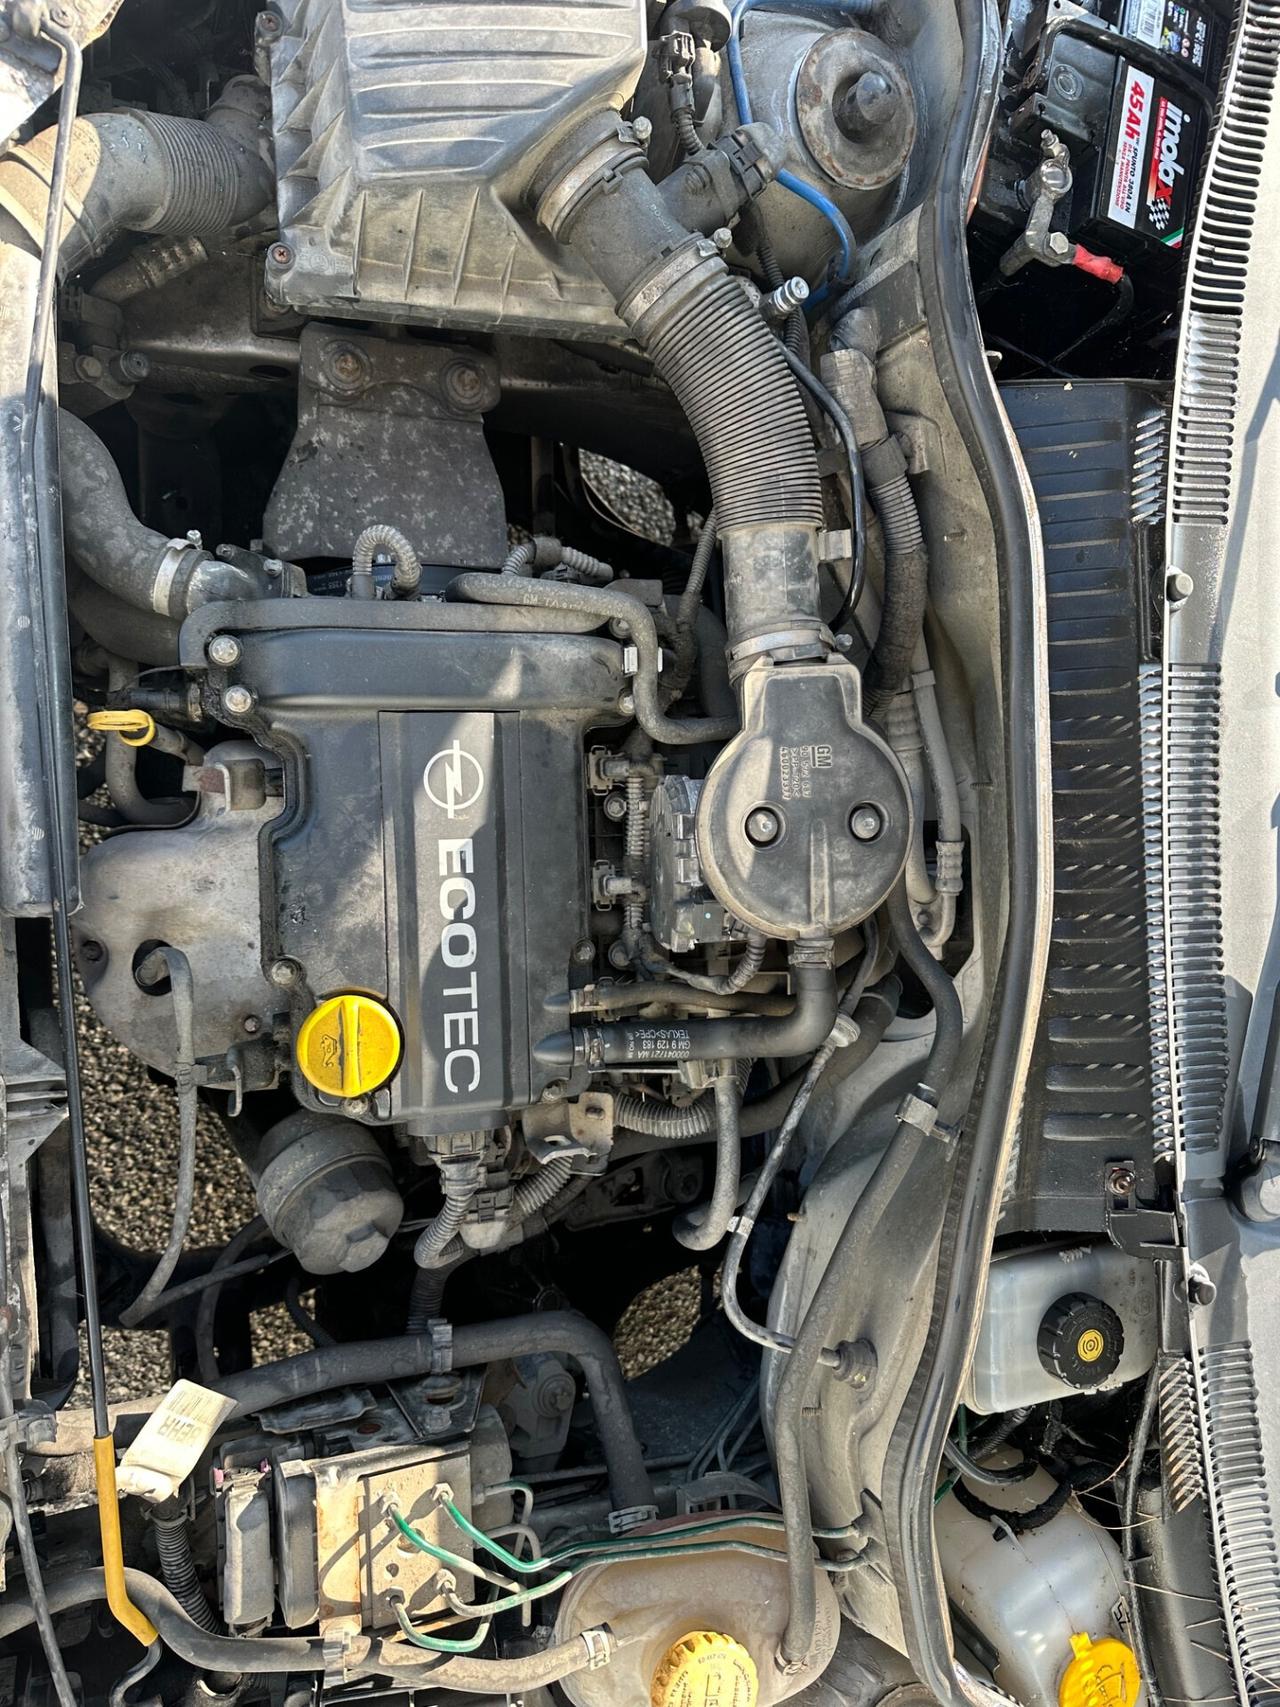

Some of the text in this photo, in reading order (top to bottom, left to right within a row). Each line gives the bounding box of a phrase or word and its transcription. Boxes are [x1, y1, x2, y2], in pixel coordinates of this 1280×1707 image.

[1125, 81, 1144, 142] 45Ah
[1130, 146, 1138, 177] SPUNTO
[1156, 101, 1190, 208] imolax
[1123, 159, 1131, 183] PRONTA
[1115, 161, 1125, 207] MANUTENZIONE
[1120, 184, 1128, 209] ALL'USO
[1125, 201, 1131, 213] EN
[817, 745, 832, 768] GM
[438, 838, 480, 1093] ECOTEC
[657, 1040, 669, 1049] 129
[671, 1040, 676, 1049] 9
[678, 1040, 690, 1049] GM
